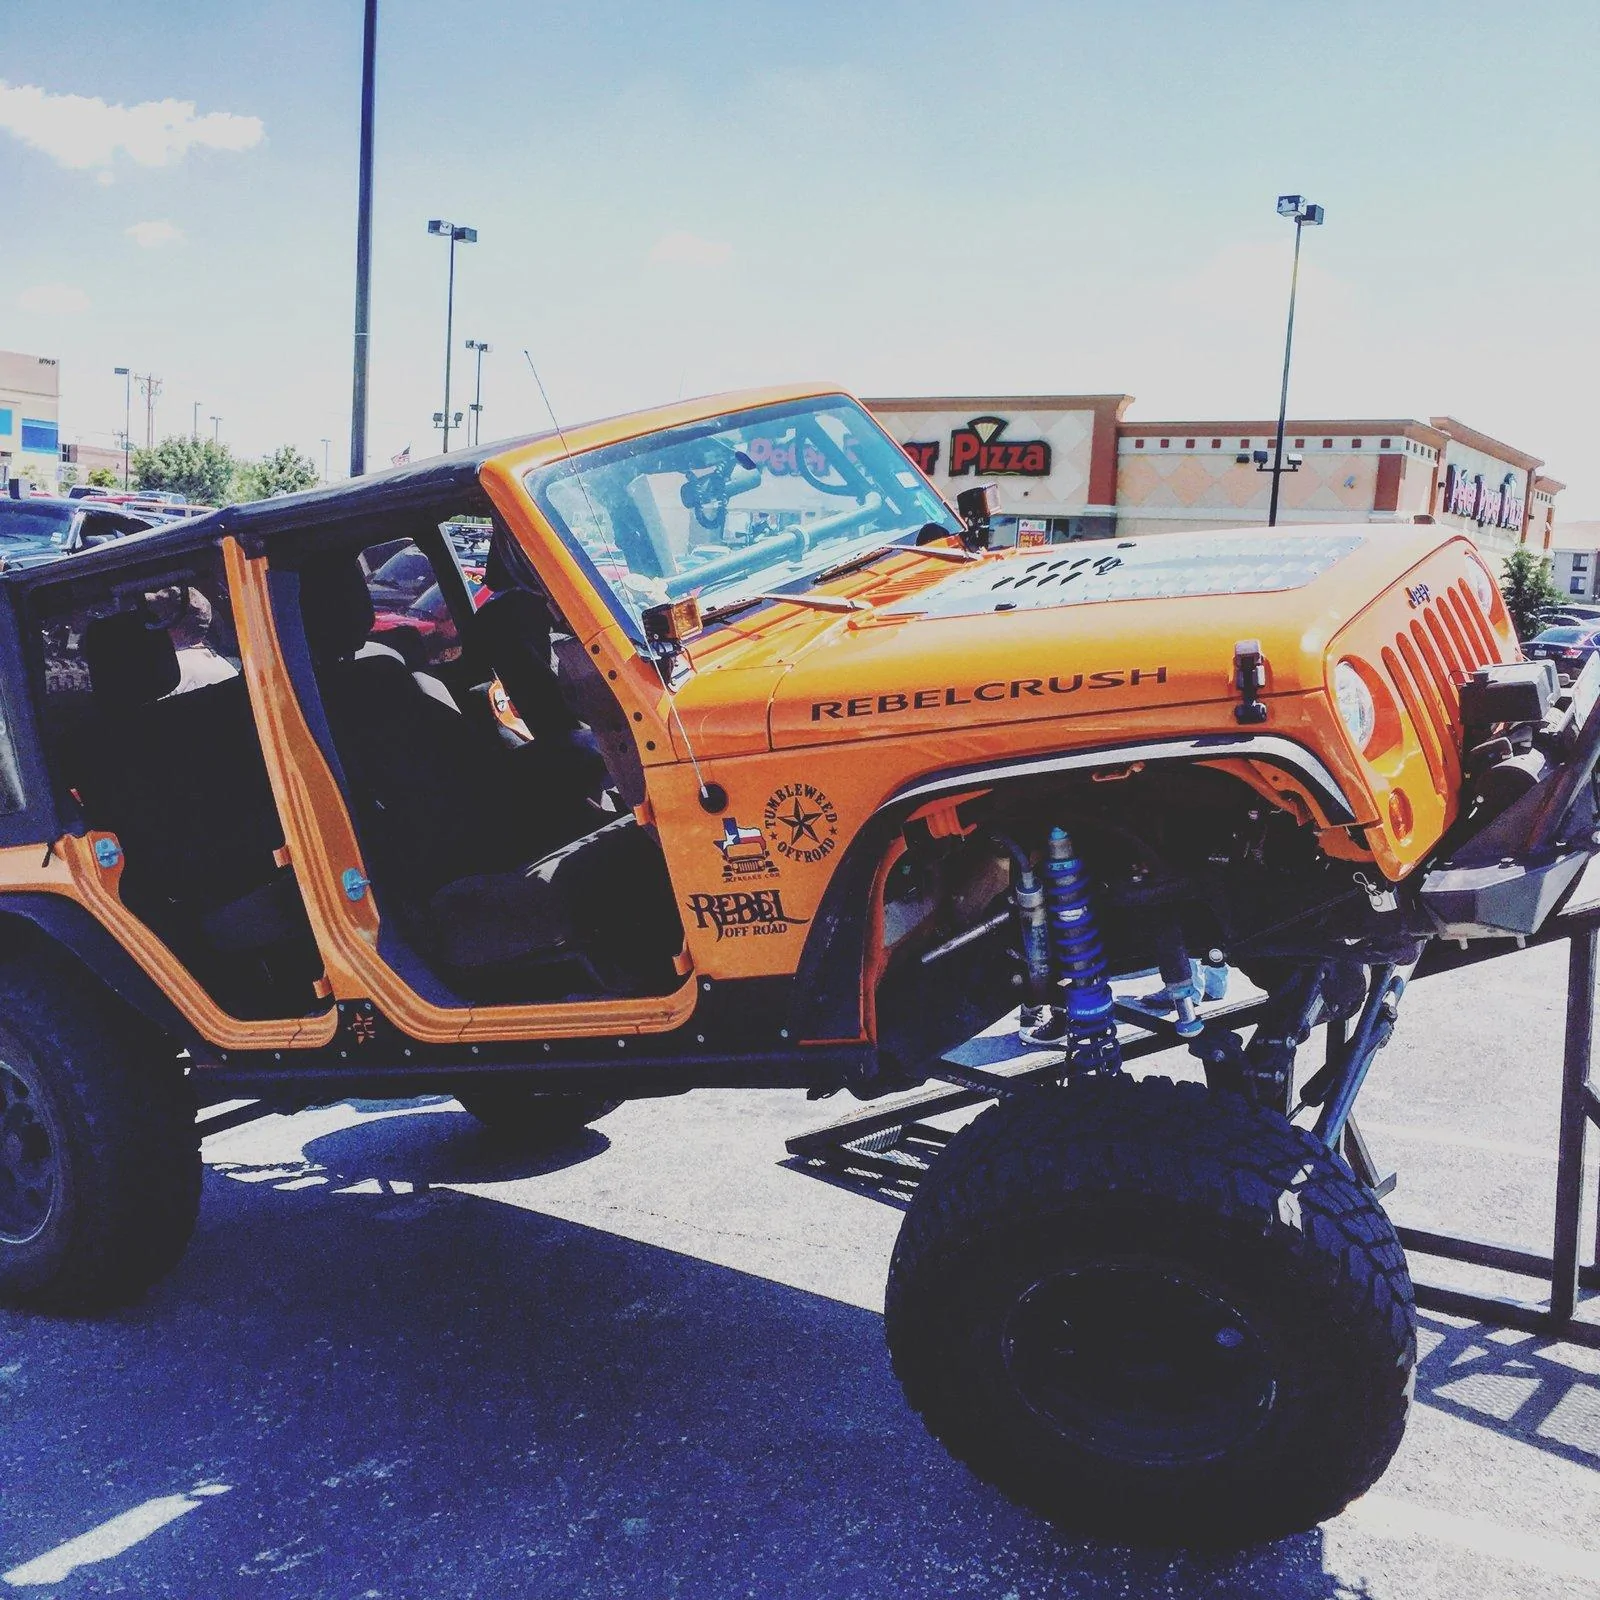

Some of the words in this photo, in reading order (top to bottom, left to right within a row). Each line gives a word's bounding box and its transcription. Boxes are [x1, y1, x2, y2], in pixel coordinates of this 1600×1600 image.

[953, 433, 1045, 471] Pizza
[811, 667, 1167, 721] REBELCRUSH
[764, 783, 838, 829] TUMBLEWEED
[777, 837, 835, 863] OFFROAD
[685, 889, 810, 942] REBEL
[725, 927, 749, 938] OFF
[753, 923, 788, 936] ROAD
